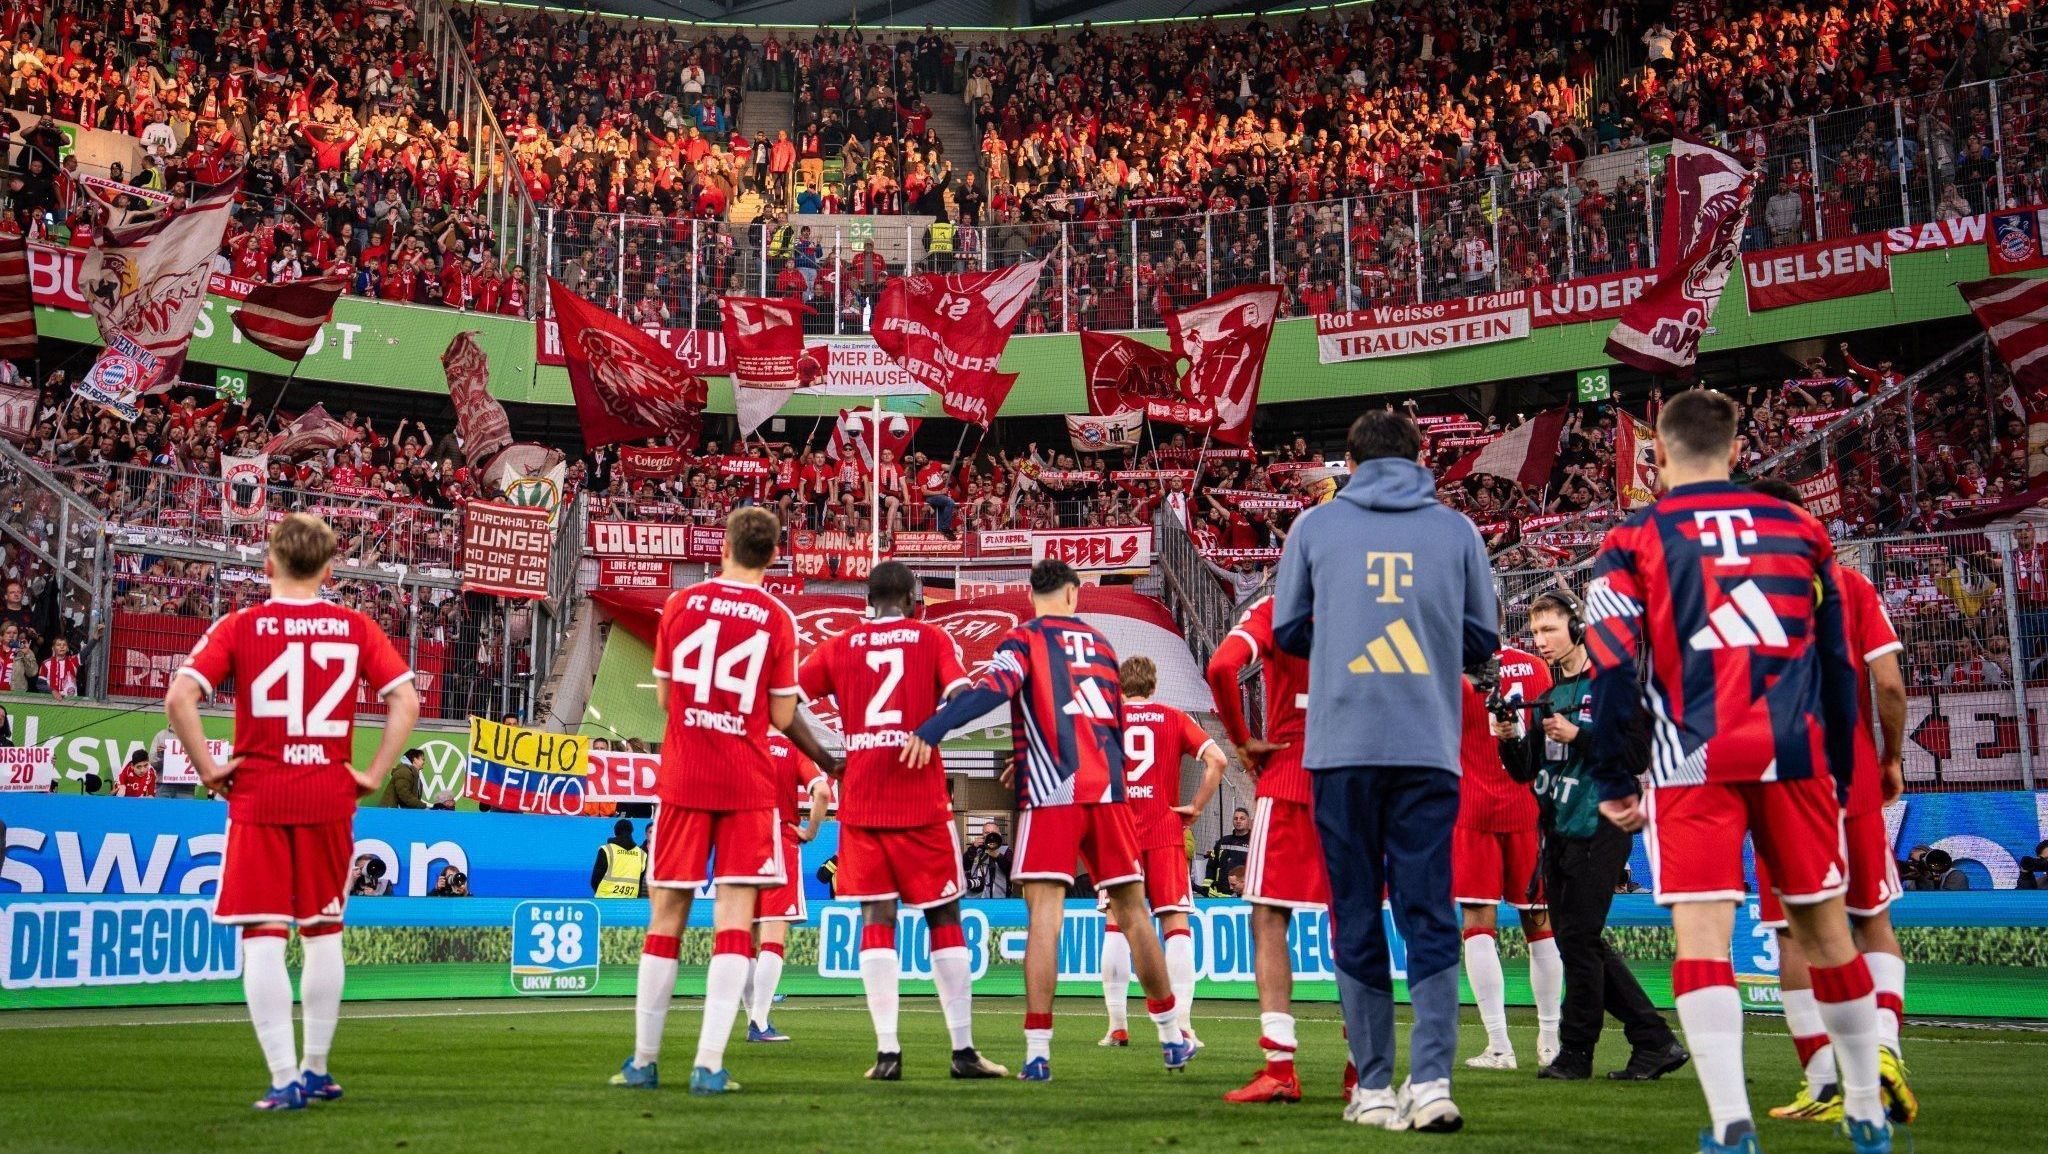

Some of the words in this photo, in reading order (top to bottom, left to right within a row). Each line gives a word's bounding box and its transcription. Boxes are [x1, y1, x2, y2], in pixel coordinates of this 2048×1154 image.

[129, 188, 169, 203] BAYERN
[852, 223, 872, 236] 32
[1887, 214, 1986, 252] SAW
[1749, 241, 1883, 289] UELSEN
[1319, 313, 1352, 330] Rot
[1374, 302, 1445, 325] Weisse
[1466, 289, 1525, 313] Traun
[1335, 316, 1514, 357] TRAUNSTEIN
[220, 376, 245, 394] 29
[1580, 377, 1608, 394] 33
[634, 454, 674, 470] Colegio
[470, 510, 550, 531] DURCHHALTEN
[467, 525, 549, 553] JUNGS!
[594, 524, 686, 556] COLEGIO
[466, 548, 485, 562] NO
[488, 549, 514, 565] ONE
[519, 553, 547, 569] CAN
[1045, 536, 1139, 567] REBELS
[464, 562, 512, 583] STOP
[515, 569, 545, 588] US!
[610, 562, 627, 570] LOVE
[628, 562, 637, 570] FC
[638, 562, 663, 571] BAYERN
[795, 553, 825, 575] RED
[614, 576, 632, 585] HATE
[686, 595, 706, 612] FC
[709, 597, 771, 626] BAYERN
[257, 618, 279, 637] FC
[284, 616, 350, 638] BAYERN
[850, 633, 867, 648] FC
[870, 629, 921, 646] BAYERN
[672, 618, 771, 715] 44
[251, 641, 361, 738] 42
[864, 647, 905, 728] 2
[1126, 712, 1165, 724] BAYERN
[283, 743, 331, 766] KARL
[473, 718, 580, 772] LUCHO
[1123, 725, 1155, 782] 9
[10, 764, 34, 784] 20
[585, 755, 662, 796] RED
[466, 757, 491, 801] EL
[499, 767, 586, 817] FLACO
[1126, 785, 1154, 799] KANE
[612, 884, 635, 896] 2497
[531, 906, 584, 921] Radio
[9, 909, 81, 979] DIE
[90, 906, 238, 976] REGION
[529, 922, 583, 964] 38
[523, 975, 552, 990] UKW
